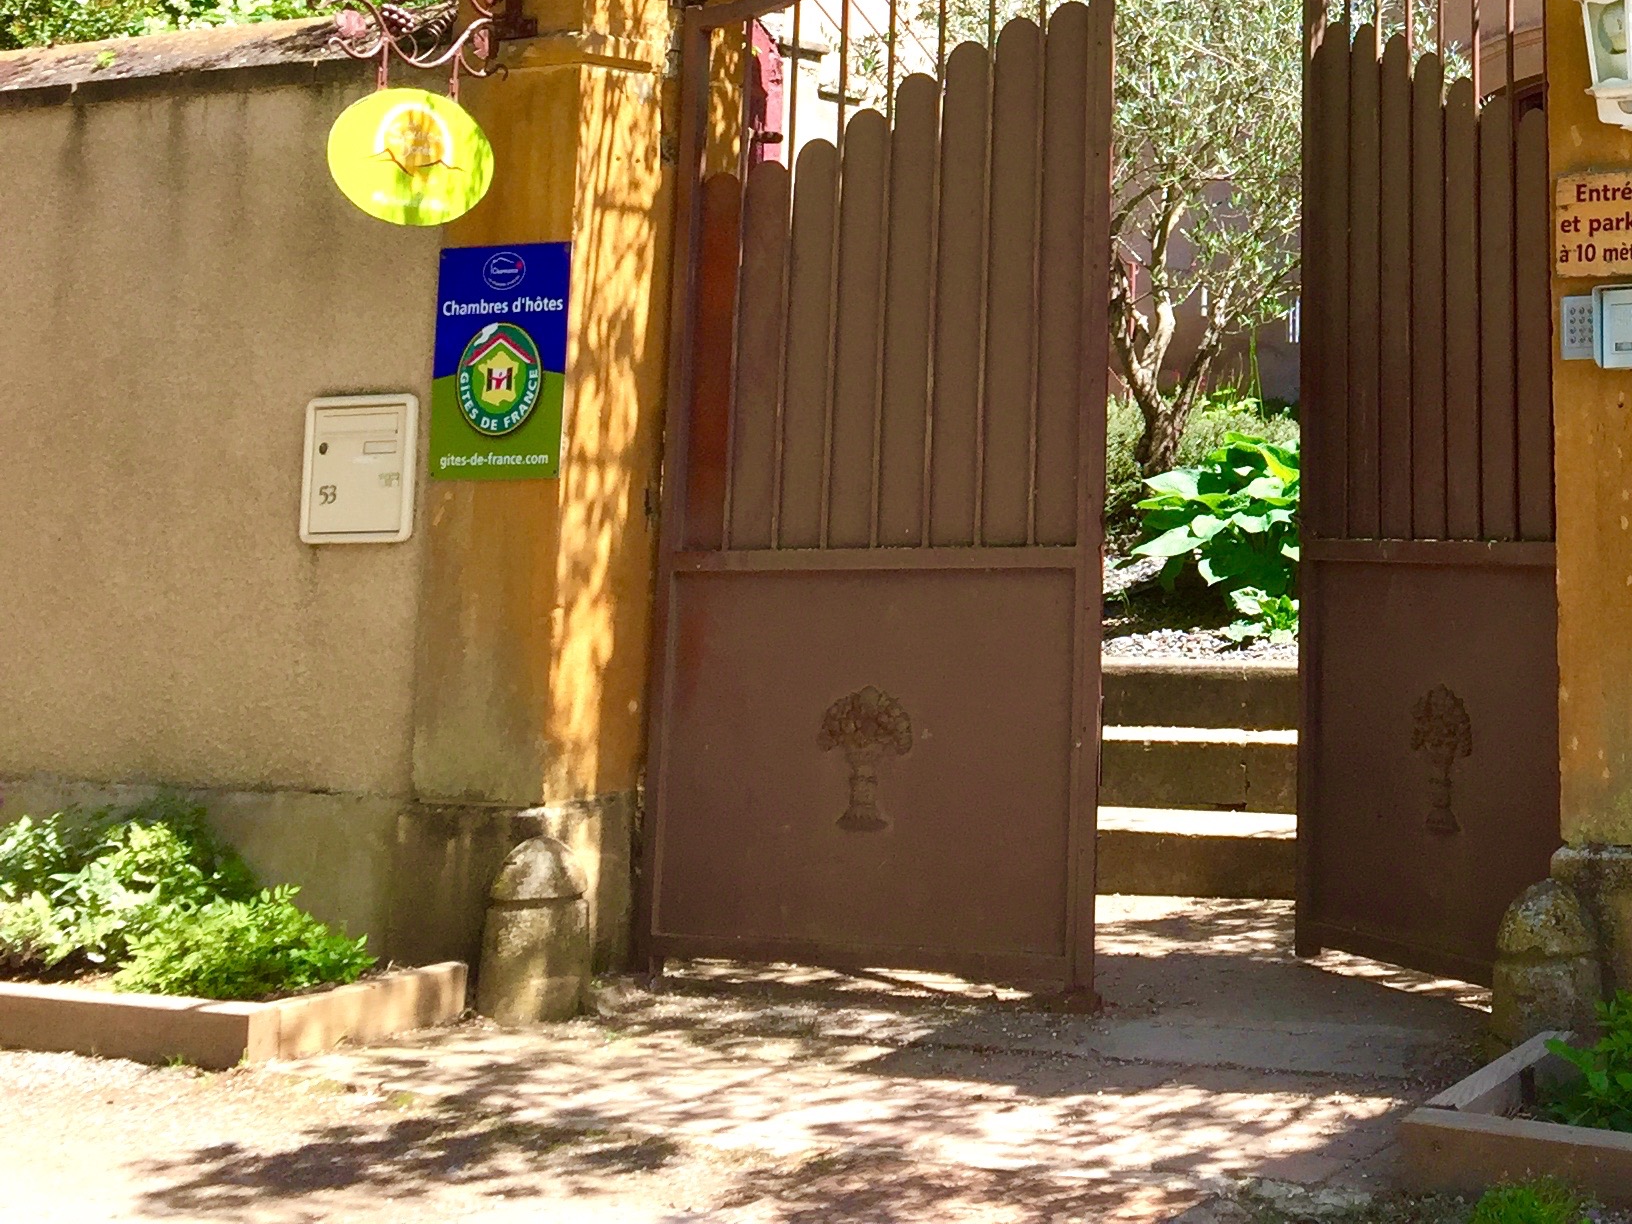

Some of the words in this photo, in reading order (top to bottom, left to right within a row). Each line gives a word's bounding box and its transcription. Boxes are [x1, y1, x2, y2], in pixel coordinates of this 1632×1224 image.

[1560, 216, 1581, 233] et
[1559, 244, 1569, 263] à
[1576, 243, 1596, 262] 10
[442, 298, 509, 316] Chambres
[512, 296, 563, 313] d'hôtes
[480, 416, 499, 431] DE
[503, 369, 539, 429] FRANCE
[440, 452, 549, 469] gites-de-france.com
[318, 484, 337, 506] 53
